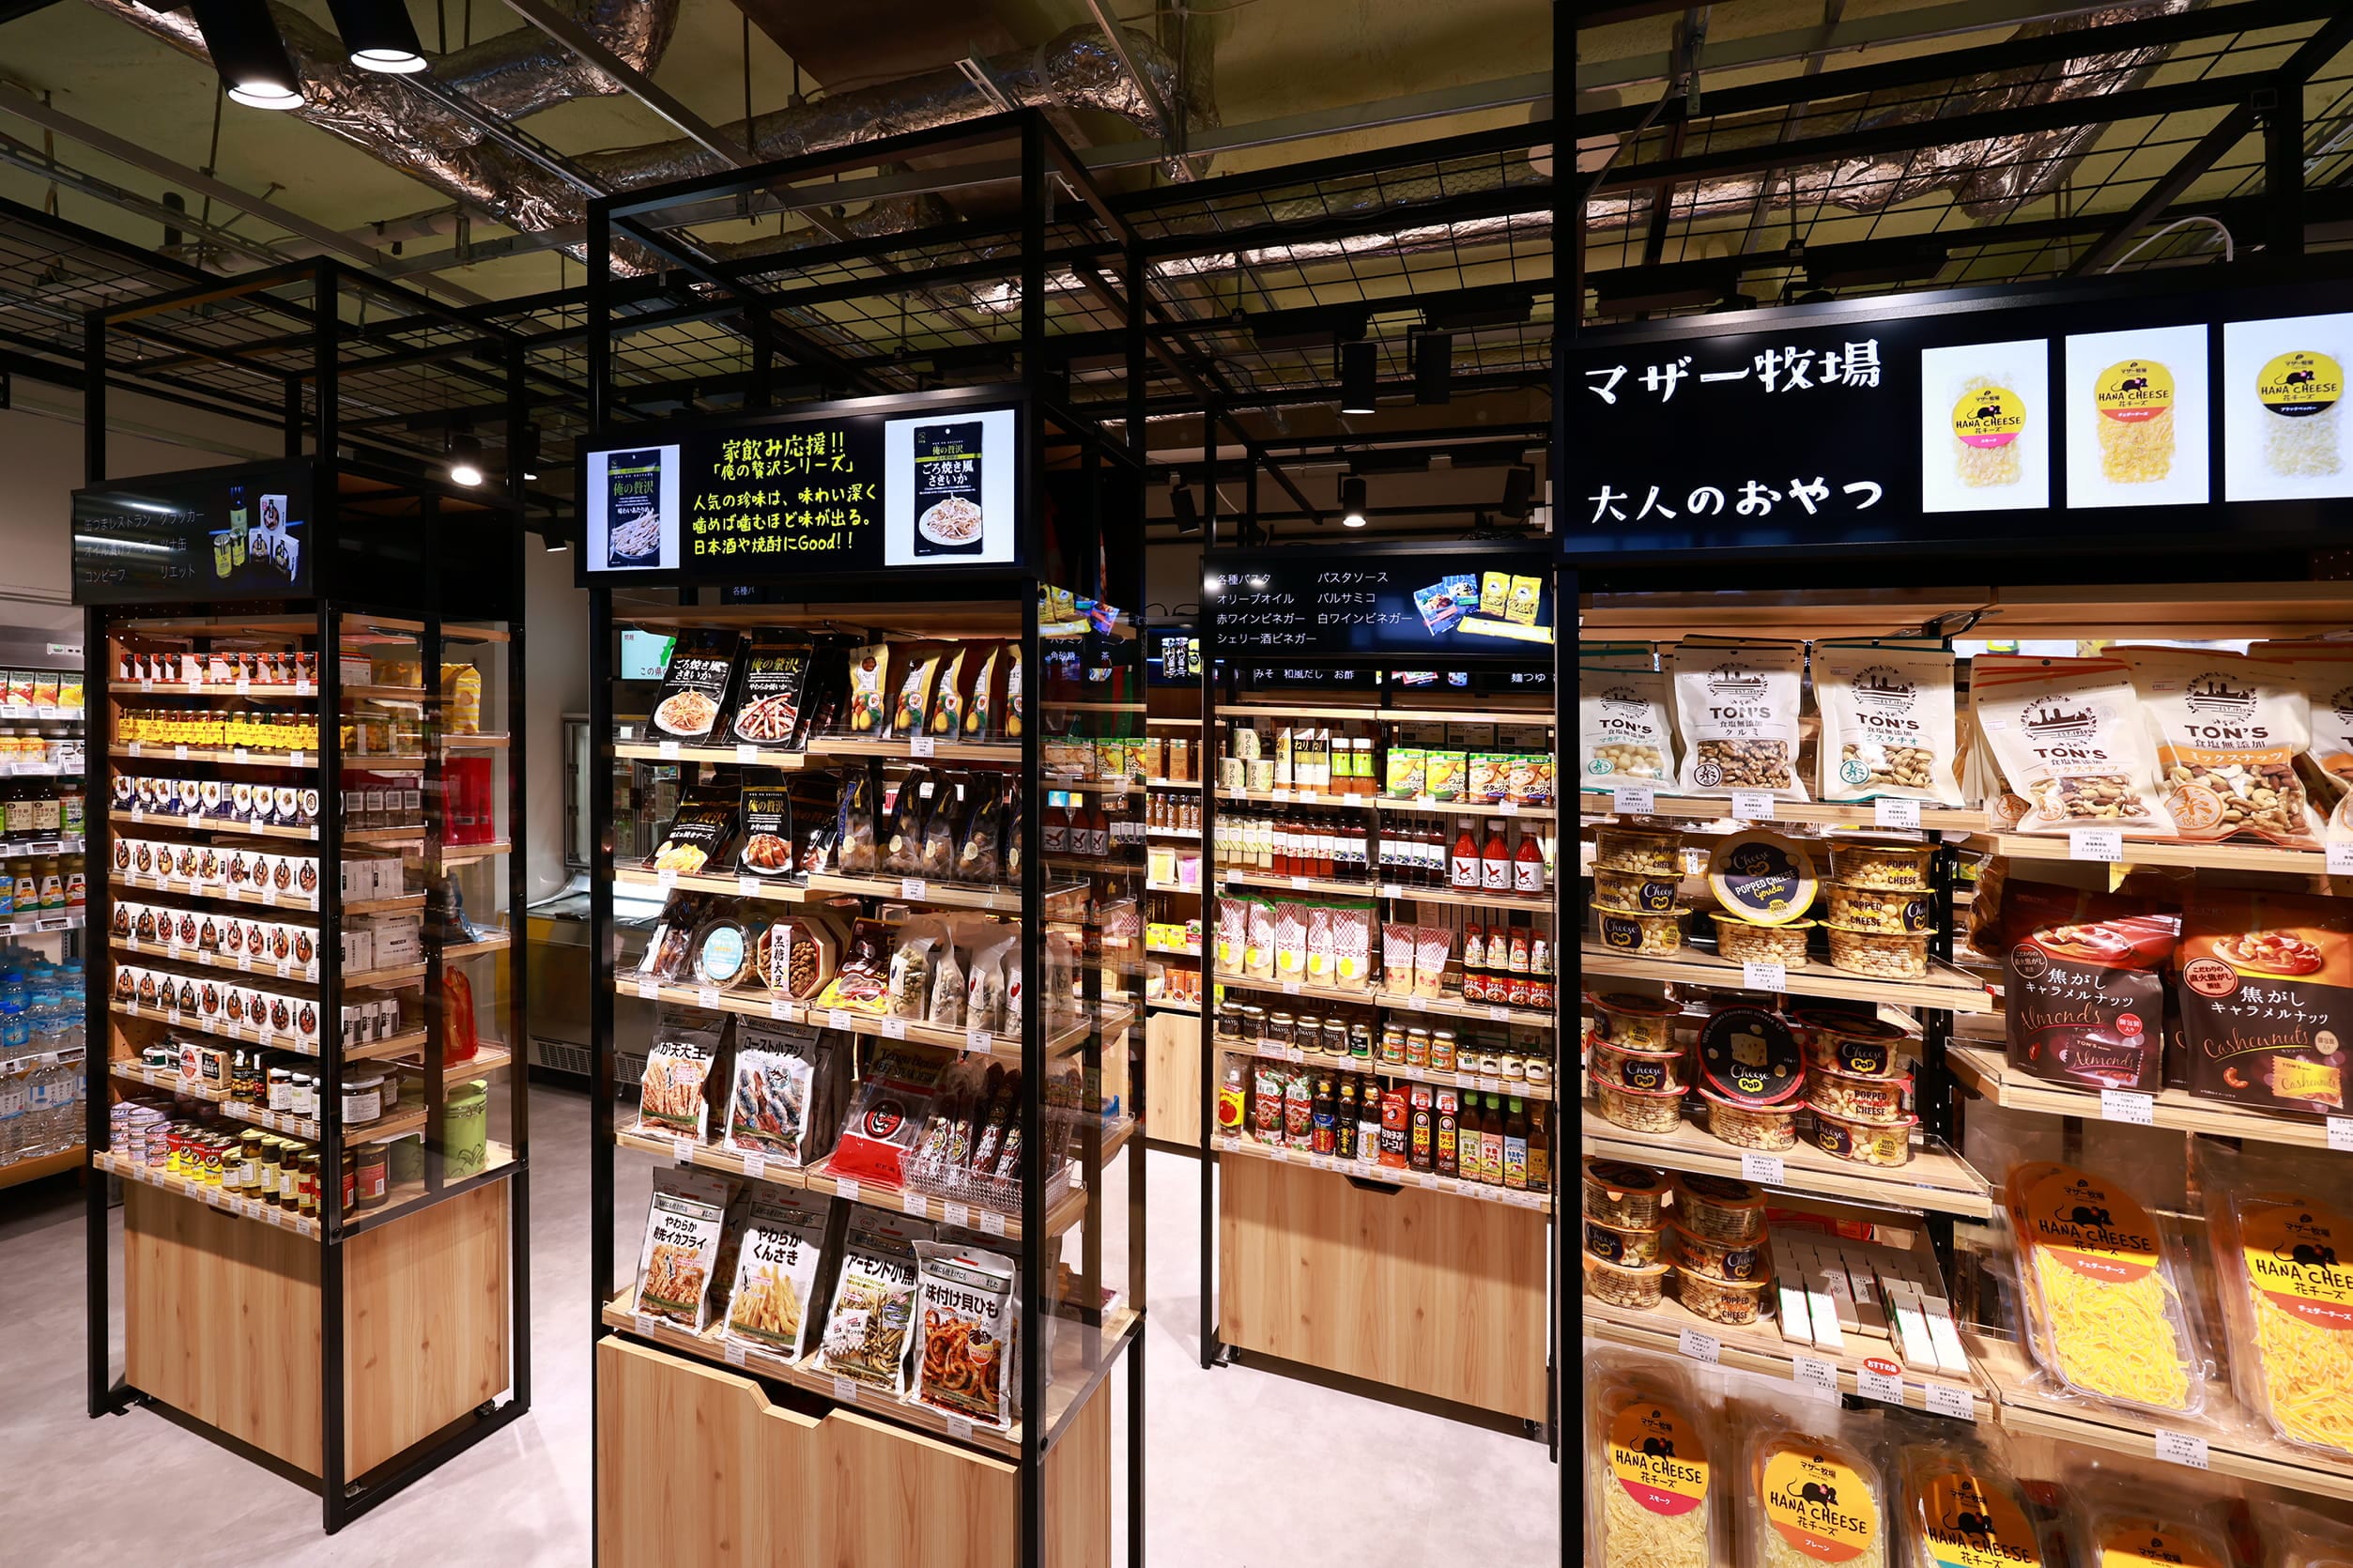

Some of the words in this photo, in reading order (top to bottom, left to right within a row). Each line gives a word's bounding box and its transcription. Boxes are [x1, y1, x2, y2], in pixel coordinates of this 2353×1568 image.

[1585, 339, 1882, 406] マザー牧場
[2099, 392, 2124, 401] HANA
[2128, 390, 2169, 400] CHEESE
[2261, 386, 2289, 395] HANA
[2293, 383, 2338, 393] CHEESE
[1956, 420, 1980, 428] HANA
[1983, 417, 2021, 427] CHEESE
[1588, 476, 1884, 524] 大人のおやつ
[1317, 572, 1389, 584] パスタソース
[1217, 592, 1295, 605] オリーブオイル
[1317, 592, 1376, 604] バルサミコ
[1217, 613, 1305, 625] 赤ワインビネガー
[1317, 612, 1413, 624] 白ワインビネガー
[1217, 633, 1317, 645] シェリー酒ビネガー
[1709, 706, 1771, 719] TON'S
[1599, 718, 1653, 734] TON'S
[1855, 713, 1919, 730] TON'S
[2184, 725, 2268, 739] TON'S
[2033, 747, 2108, 760] TON'S
[2191, 751, 2284, 762] ミックスナッツ
[1735, 879, 1767, 896] POPPED
[1765, 869, 1797, 885] CHEESE
[1887, 876, 1916, 884] CHEESE
[1753, 885, 1785, 901] Gouda
[1850, 915, 1882, 927] CHEESE
[773, 934, 785, 989] 黒糖大豆
[2048, 968, 2106, 990] 焦がし
[2190, 973, 2233, 982] 直火焦がし
[2025, 981, 2133, 1007] キャラメルナッツ
[2239, 986, 2306, 1007] 焦がし
[2021, 1002, 2103, 1030] Almonds
[2211, 1001, 2329, 1024] キャラメルナッツ
[744, 1036, 806, 1060] ロースト小アジ
[2076, 1039, 2098, 1049] TON'S
[2203, 1024, 2310, 1058] Cashewnuts
[1841, 1043, 1884, 1059] Cheese
[2072, 1050, 2134, 1068] Almonds
[1626, 1061, 1663, 1076] Cheese
[1730, 1064, 1771, 1081] Cheese
[1855, 1106, 1886, 1116] CHEESE
[665, 1216, 698, 1233] やわらか
[757, 1225, 802, 1249] やわらか
[2038, 1219, 2081, 1239] HANA
[2085, 1228, 2152, 1252] CHEESE
[753, 1244, 798, 1266] くんさき
[2074, 1239, 2121, 1256] 花チーズ
[847, 1250, 915, 1286] アーモンド小魚
[2077, 1260, 2127, 1275] チェダーチーズ
[2256, 1258, 2302, 1283] HANA
[1721, 1295, 1749, 1304] POPPED
[2294, 1283, 2346, 1300] 花チーズ
[925, 1283, 999, 1318] 味付け貝ひも
[1722, 1310, 1747, 1319] CHEESE
[2298, 1303, 2353, 1321] チェダーチーズ
[1616, 1449, 1648, 1470] HANA
[1652, 1460, 1703, 1484] CHEESE
[1640, 1471, 1677, 1488] 花チーズ
[1649, 1494, 1670, 1505] スモーク
[1770, 1490, 1806, 1515] HANA
[1810, 1506, 1868, 1535] CHEESE
[1797, 1515, 1838, 1537] 花チーズ
[1805, 1538, 1830, 1552] プレーン
[1928, 1527, 1968, 1550] HANA
[1971, 1536, 2033, 1565] CHEESE
[1961, 1551, 2004, 1568] 花チーズ
